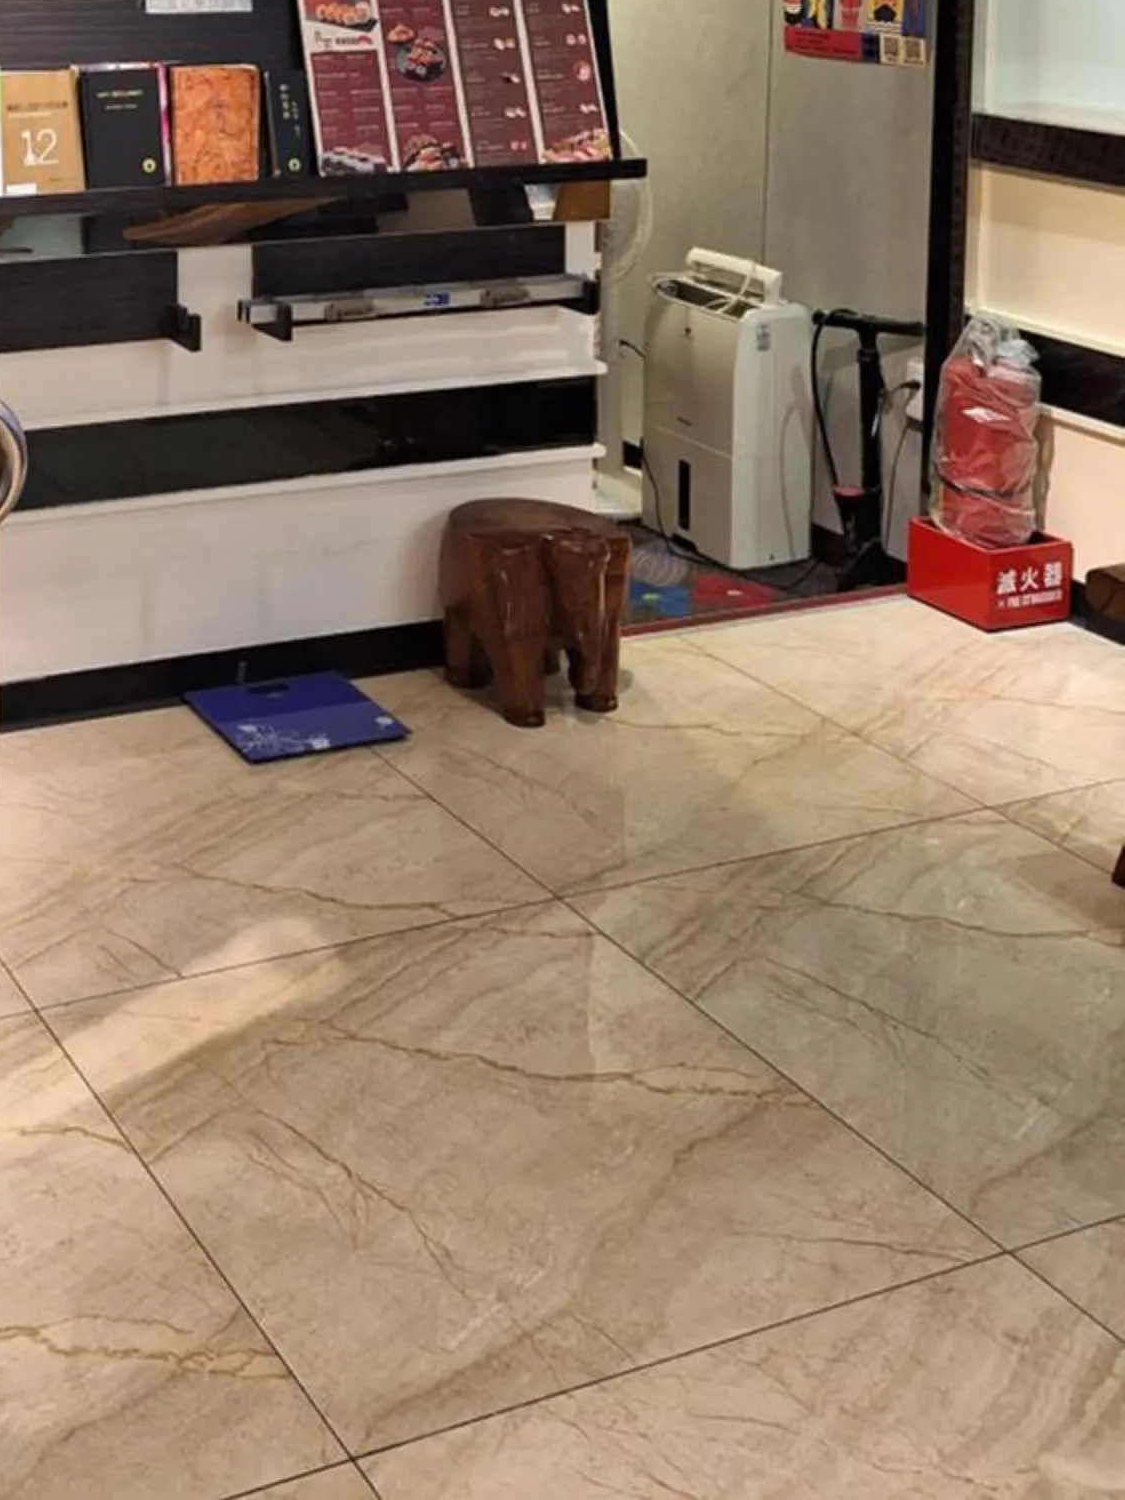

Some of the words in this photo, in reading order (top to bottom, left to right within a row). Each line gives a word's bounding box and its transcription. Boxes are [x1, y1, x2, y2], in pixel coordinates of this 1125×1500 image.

[20, 129, 59, 167] 12
[997, 561, 1063, 595] 滅火器
